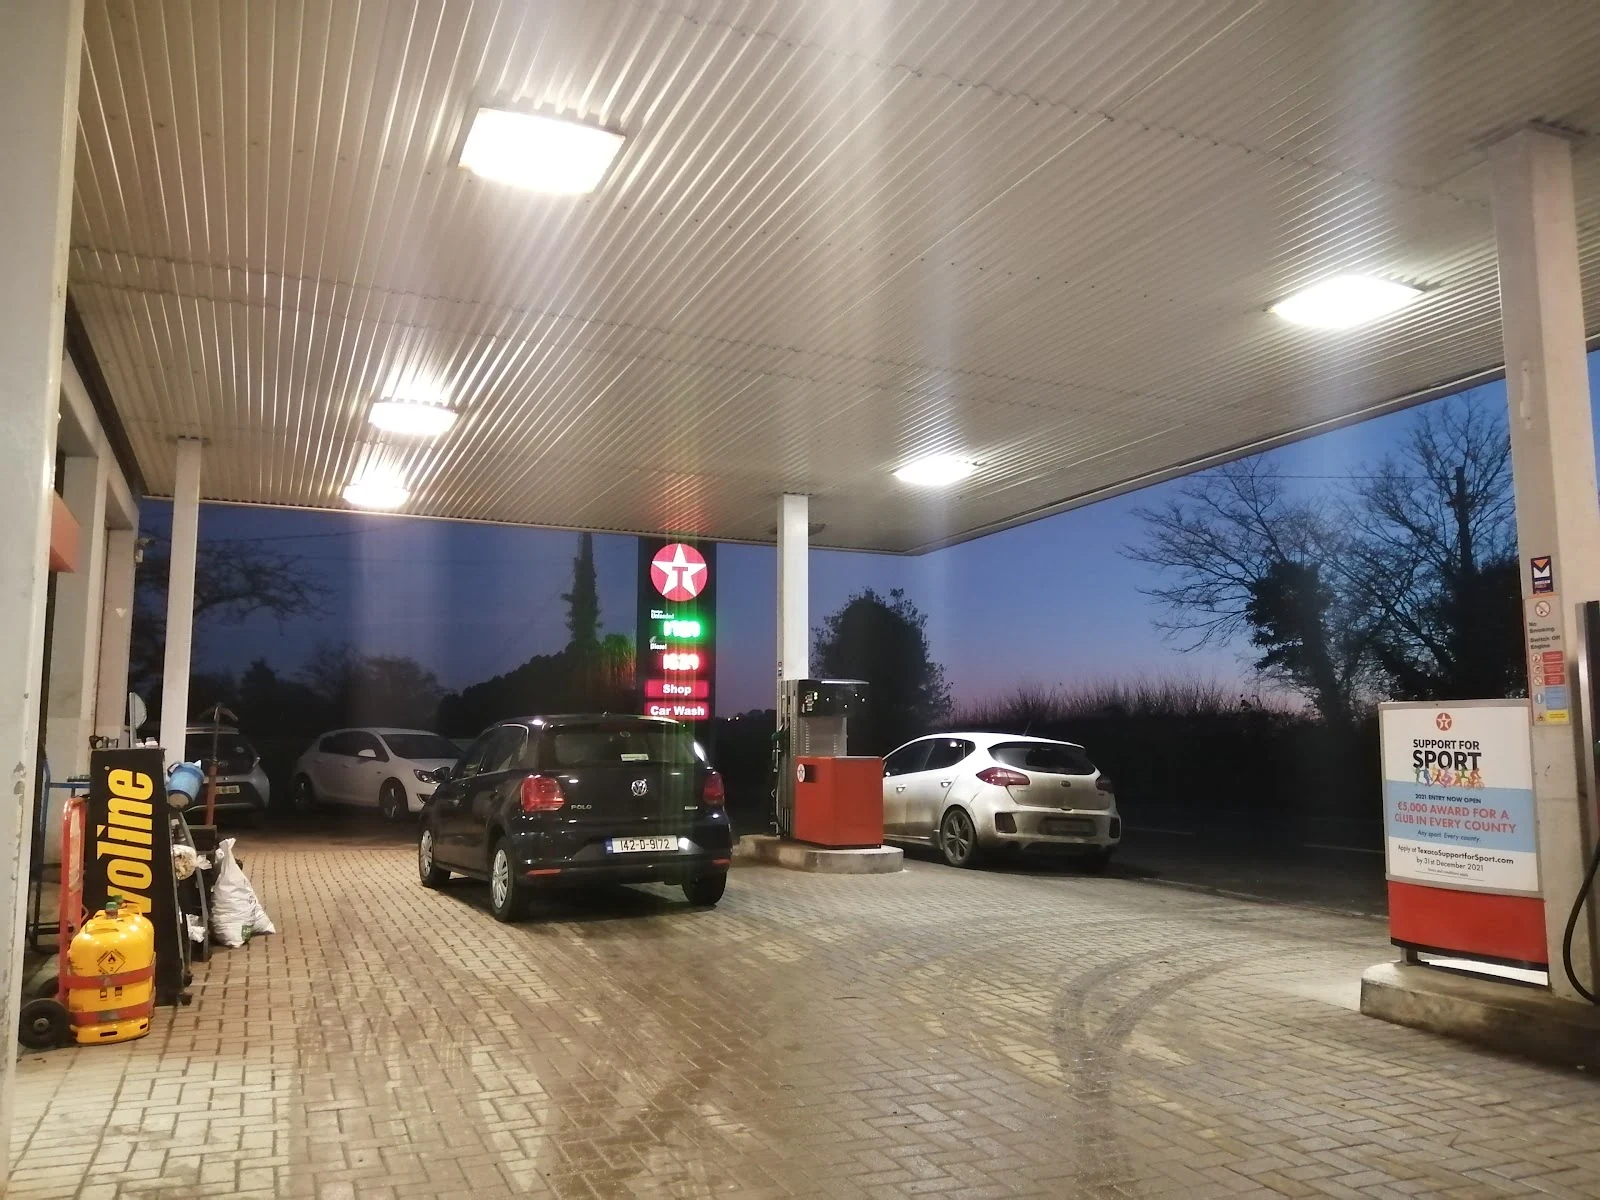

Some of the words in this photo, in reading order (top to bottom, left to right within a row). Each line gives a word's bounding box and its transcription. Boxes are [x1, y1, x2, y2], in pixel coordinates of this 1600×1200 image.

[662, 683, 692, 696] Shop
[650, 705, 672, 716] Car
[673, 705, 705, 716] Wash
[1412, 738, 1457, 750] SUPPORT
[1458, 740, 1480, 750] FOR
[1412, 749, 1482, 771] SPORT
[1397, 801, 1428, 813] €5,000
[1430, 804, 1470, 817] AWARD
[1472, 807, 1497, 819] FOR
[1500, 809, 1510, 820] A
[1395, 813, 1414, 824] CLUB
[1416, 815, 1427, 826] IN
[1429, 816, 1461, 829] EVERY
[1464, 819, 1517, 834] COUNTY
[1418, 829, 1427, 837] Any
[1443, 832, 1460, 841] Every
[620, 838, 670, 851] 142-D-9172
[1398, 844, 1411, 854] Apply
[1417, 846, 1514, 865] TexacoSupportforSport.com
[1416, 855, 1423, 865] by
[1436, 858, 1466, 870] December
[1467, 863, 1484, 872] 2021
